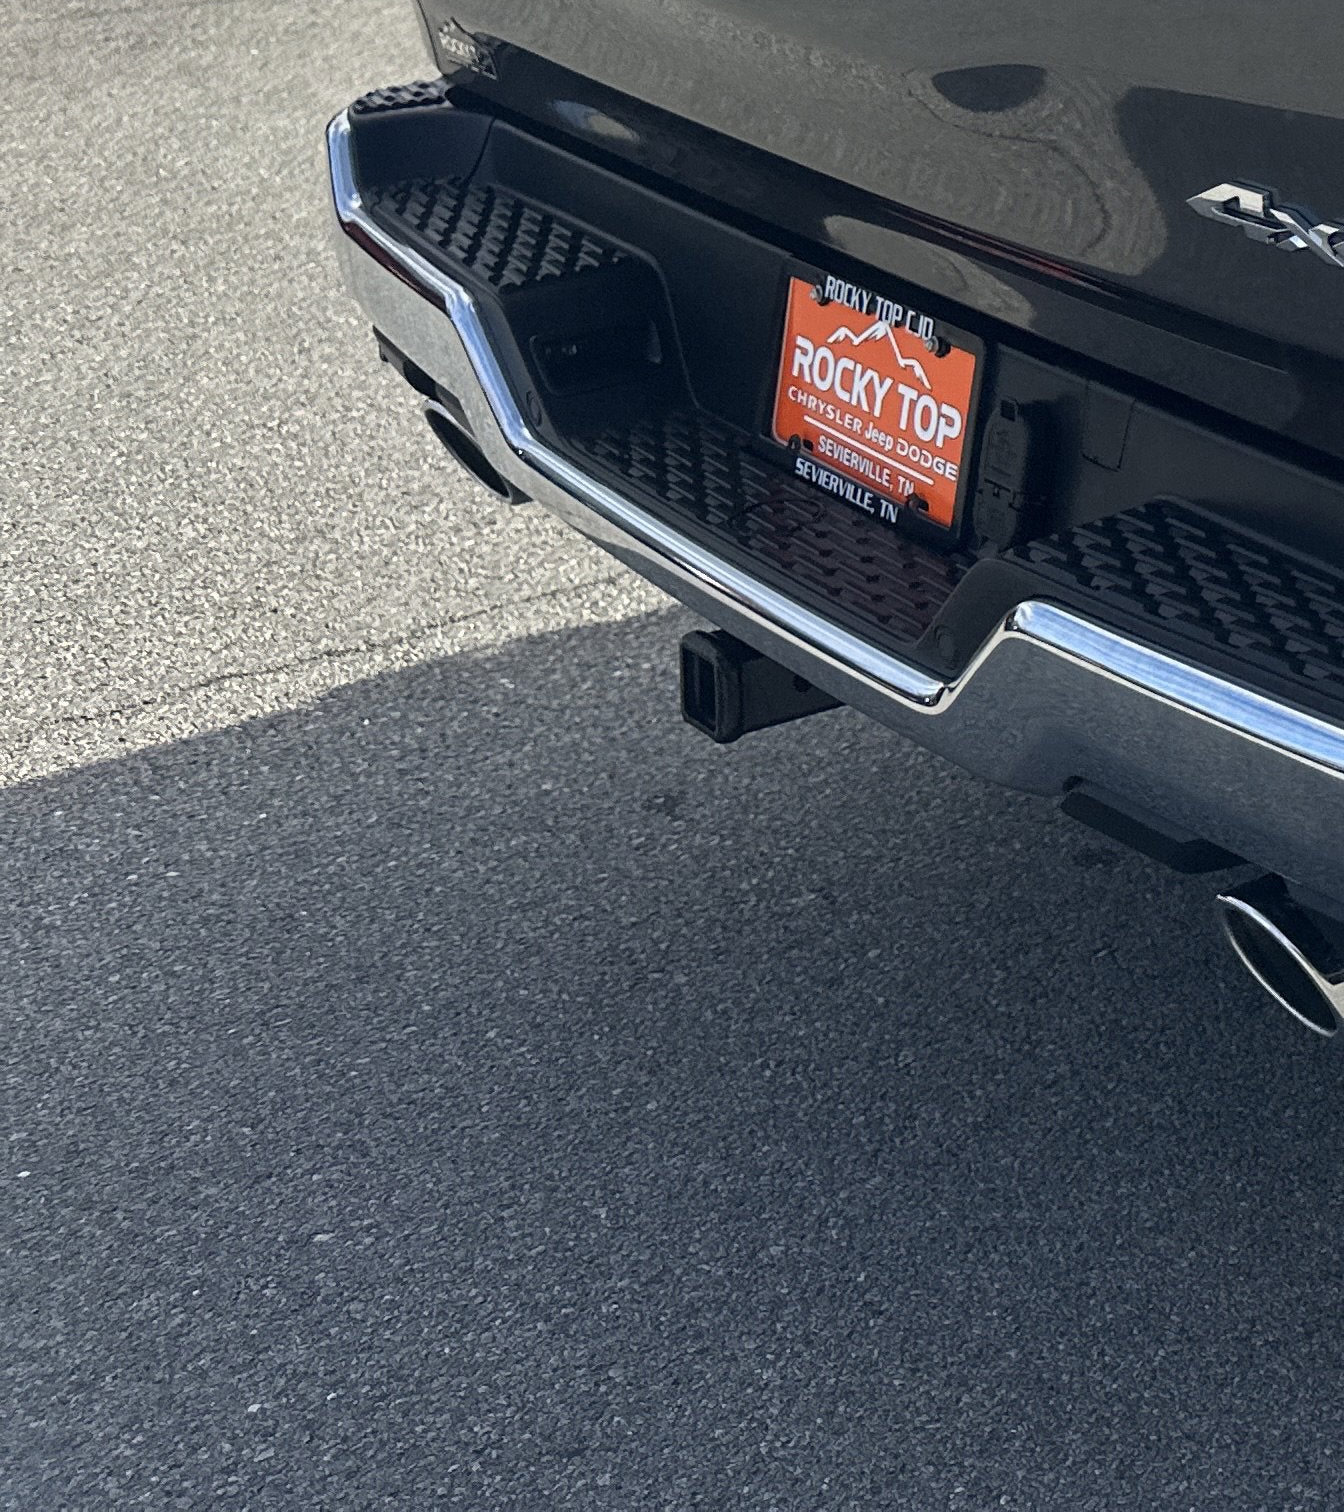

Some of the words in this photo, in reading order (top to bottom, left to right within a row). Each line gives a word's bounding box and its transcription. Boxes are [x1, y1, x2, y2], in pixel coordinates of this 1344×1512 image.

[825, 275, 872, 315] ROCKY
[875, 296, 903, 326] TOP
[792, 335, 894, 418] ROCKY
[898, 383, 962, 448] TOP
[787, 385, 863, 435] CHRYSLER
[864, 422, 894, 452] Jeep
[896, 437, 959, 481] DODGE
[817, 435, 893, 492] SEVIERVILLE,
[795, 457, 875, 515] SEVIERVILLE,
[879, 498, 899, 524] TN
